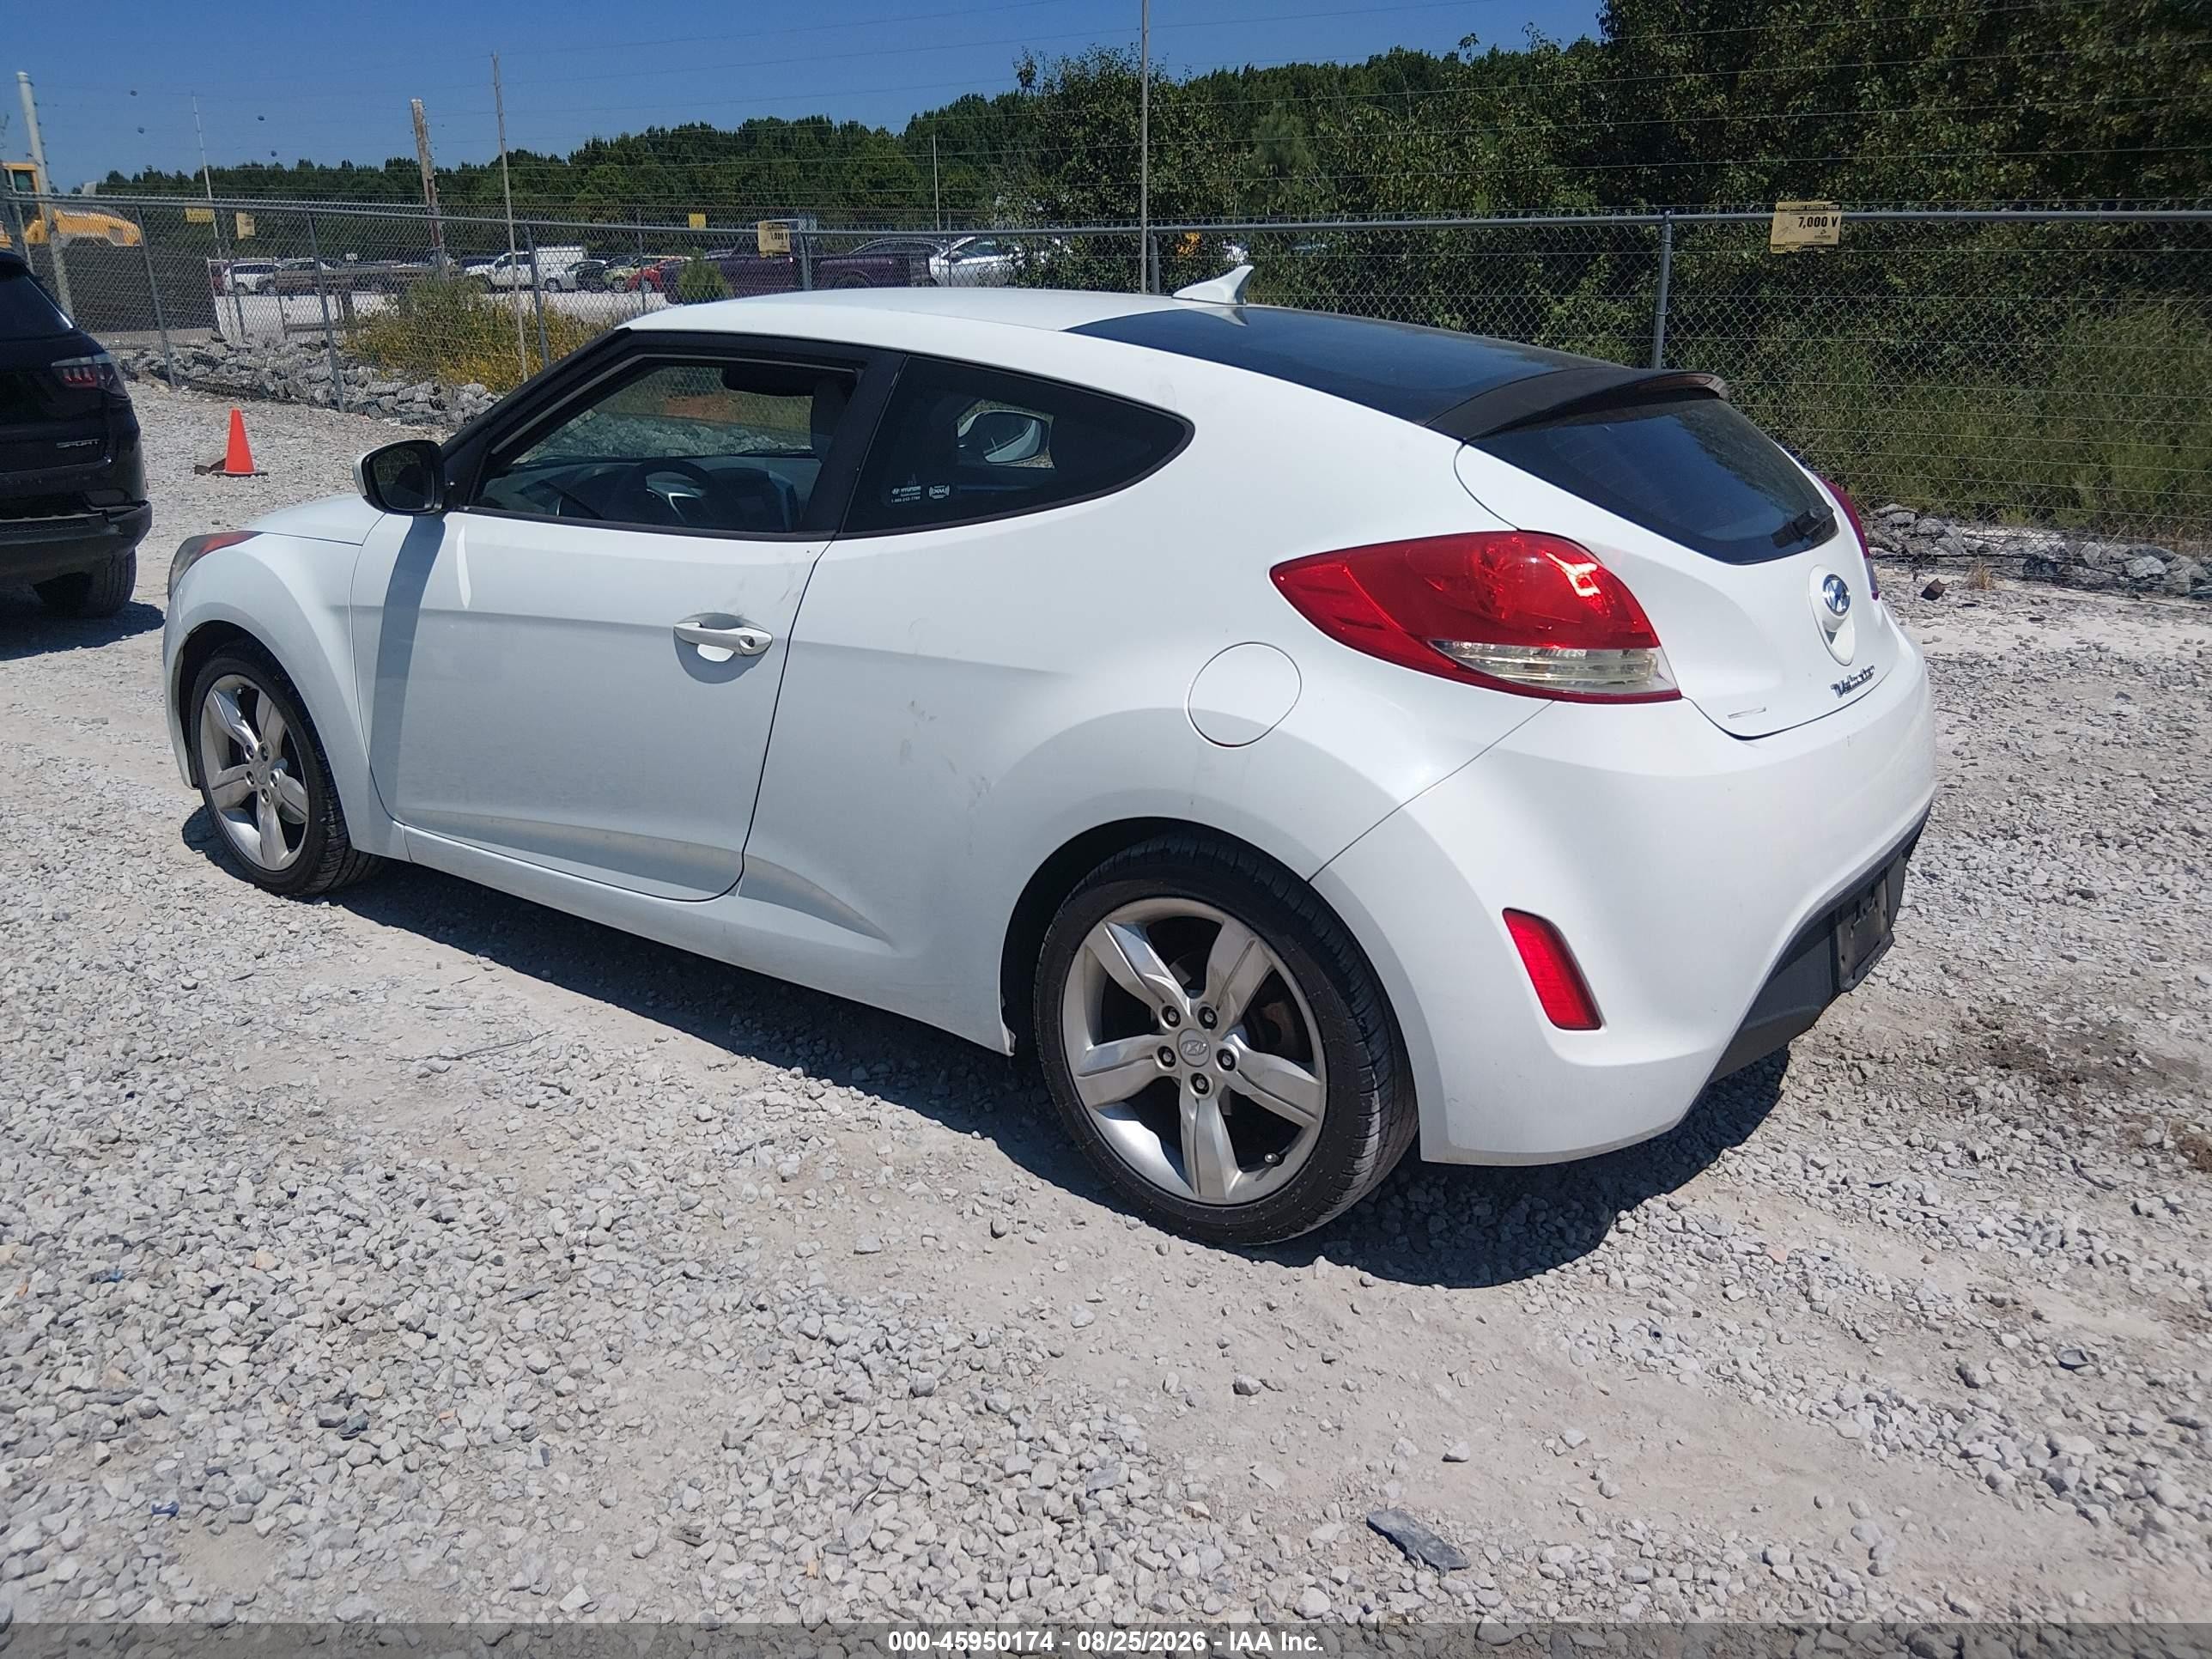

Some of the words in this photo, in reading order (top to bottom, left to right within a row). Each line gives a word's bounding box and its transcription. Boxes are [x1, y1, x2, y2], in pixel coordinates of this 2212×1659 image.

[1798, 216, 1828, 229] 7,000
[1831, 216, 1838, 228] V
[56, 438, 100, 448] SPORT
